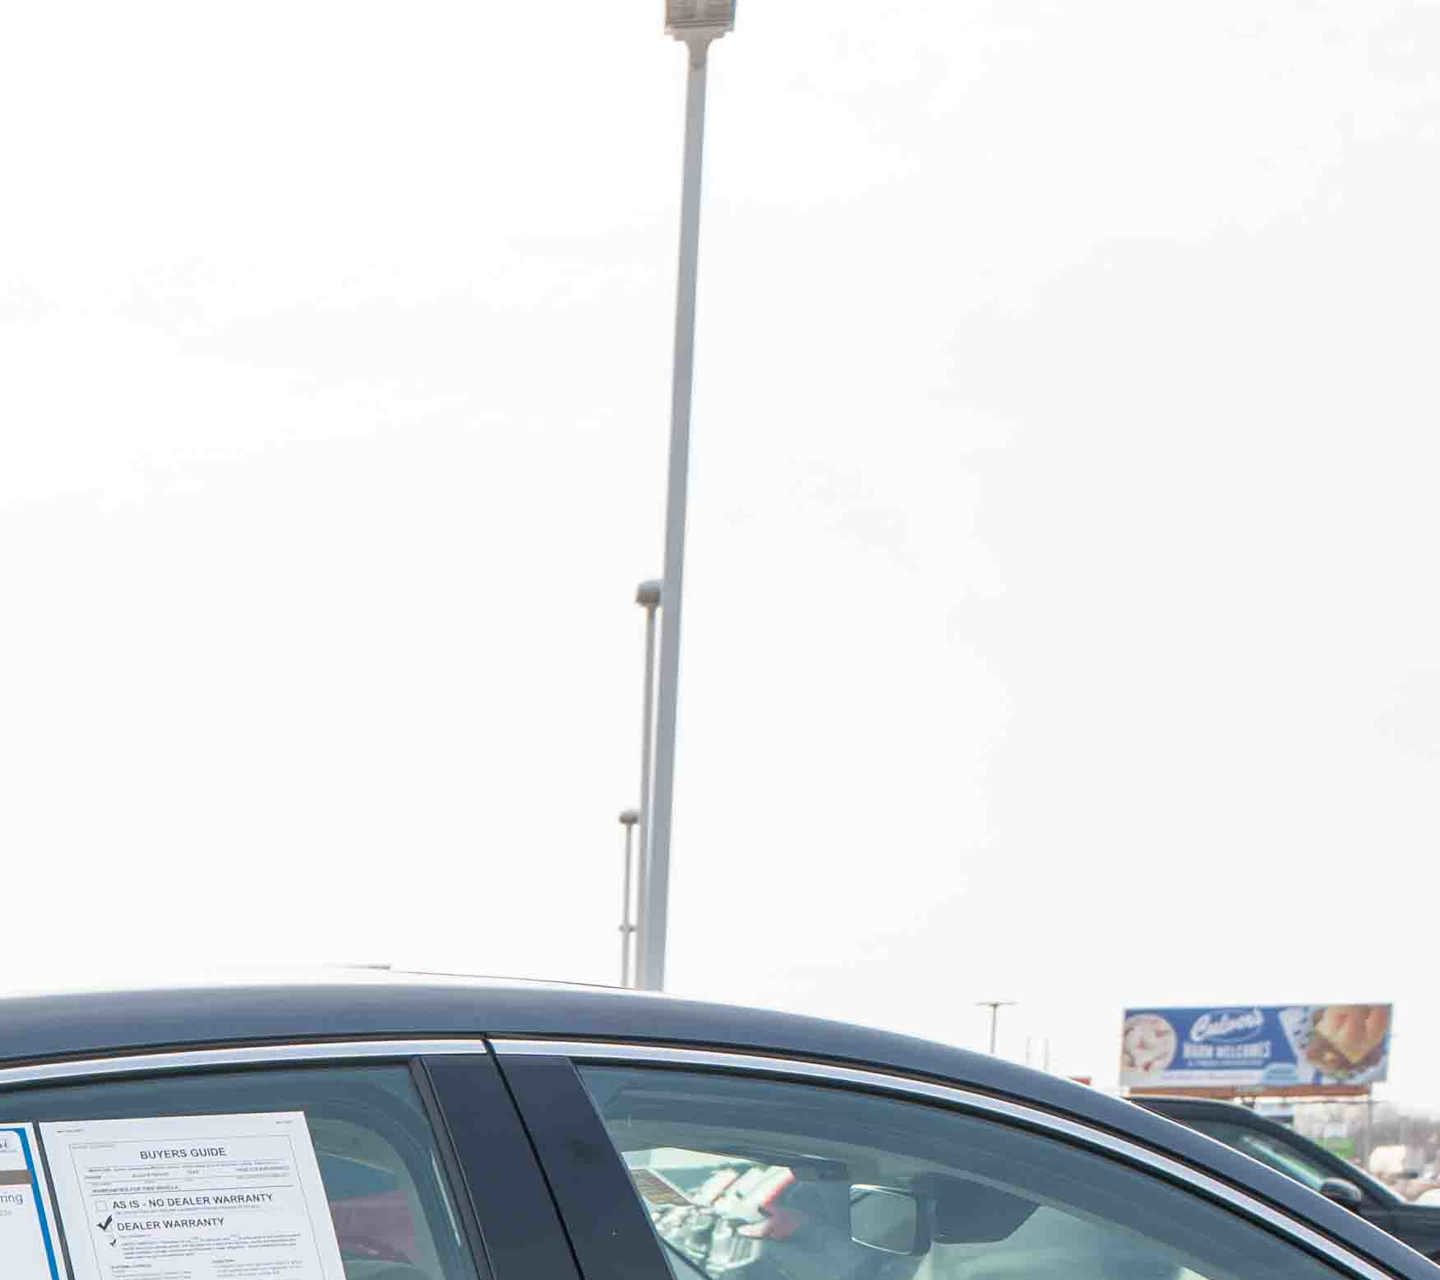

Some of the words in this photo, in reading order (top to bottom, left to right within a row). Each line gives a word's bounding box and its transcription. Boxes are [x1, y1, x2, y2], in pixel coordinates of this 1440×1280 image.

[140, 1148, 187, 1160] BUYERS
[190, 1147, 227, 1158] GUIDE
[112, 1199, 128, 1210] AS
[130, 1198, 140, 1209] IS
[149, 1197, 165, 1208] NO
[167, 1195, 211, 1207] DEALER
[213, 1192, 273, 1205] WARRANTY
[117, 1220, 161, 1232] DEALER
[164, 1217, 225, 1230] WARRANTY
